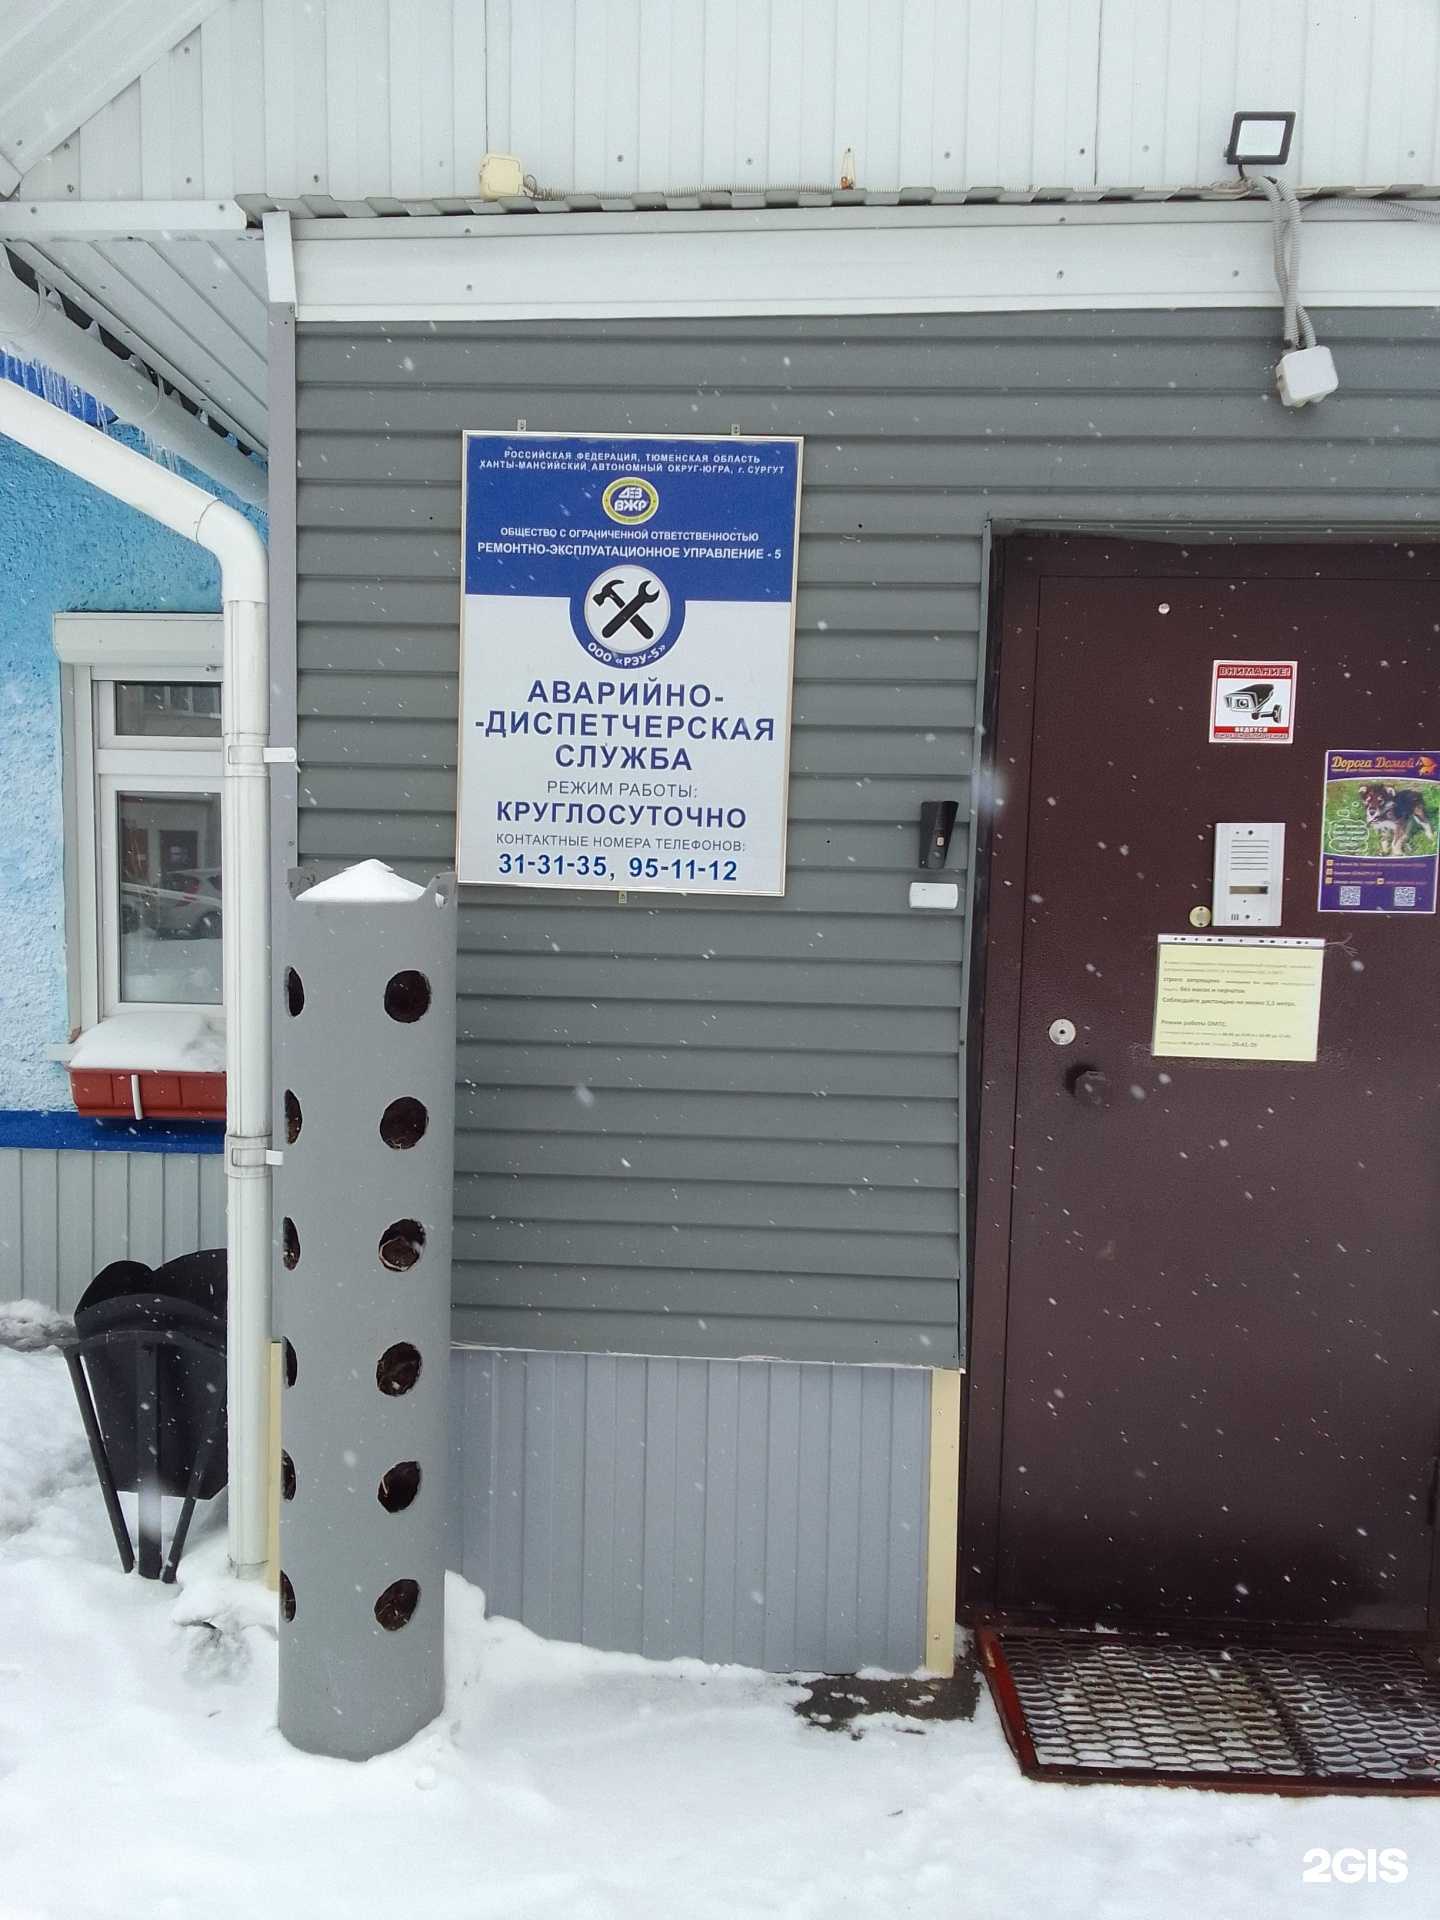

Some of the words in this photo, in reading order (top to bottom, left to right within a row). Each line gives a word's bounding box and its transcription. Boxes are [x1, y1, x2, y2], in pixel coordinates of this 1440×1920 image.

[504, 450, 572, 460] РОССИЙСКАЯ
[577, 451, 640, 462] ФЕДЕРАЦИЯ,
[645, 453, 709, 463] ТЮМЕНСКАЯ
[713, 454, 761, 464] ОБЛАСТЬ
[479, 460, 587, 471] ХАНТЫ-МАНСИЙСКИЙ
[591, 462, 663, 472] АВТОНОМНЫЙ
[667, 463, 734, 475] ОКРУГ-ЮГРА,
[747, 466, 785, 475] СУРГУТ
[614, 499, 648, 512] ВЖР
[500, 527, 557, 538] ОБЩЕСТВО
[559, 529, 567, 537] С
[569, 529, 648, 540] ОГРАНИЧЕННОЙ
[650, 531, 759, 542] ОТВЕТСТВЕННОСТЬЮ
[477, 541, 681, 558] РЕМОНТНО-ЭКСПЛУАТАЦИОННОЕ
[683, 547, 764, 559] УПРАВЛЕНИЕ
[774, 549, 782, 560] 5
[587, 642, 612, 663] ООО
[615, 644, 666, 667] «РЭУ-5»
[1219, 666, 1291, 677] ВНИМАНИЕ!
[527, 676, 724, 708] АВАРИЙНО-
[475, 709, 775, 742] -ДИСПЕТЧЕРСКАЯ
[555, 744, 693, 771] СЛУЖБА
[1331, 756, 1373, 772] Дорога
[547, 780, 613, 796] РЕЖИМ
[619, 782, 699, 798] РАБОТЫ:
[496, 800, 747, 829] КРУГЛОСУТОЧНО
[496, 833, 589, 847] КОНТАКТНЫЕ
[593, 836, 651, 849] НОМЕРА
[655, 838, 746, 852] ТЕЛЕФОНОВ:
[498, 853, 616, 881] 31-31-35,
[628, 856, 738, 882] 95-11-12
